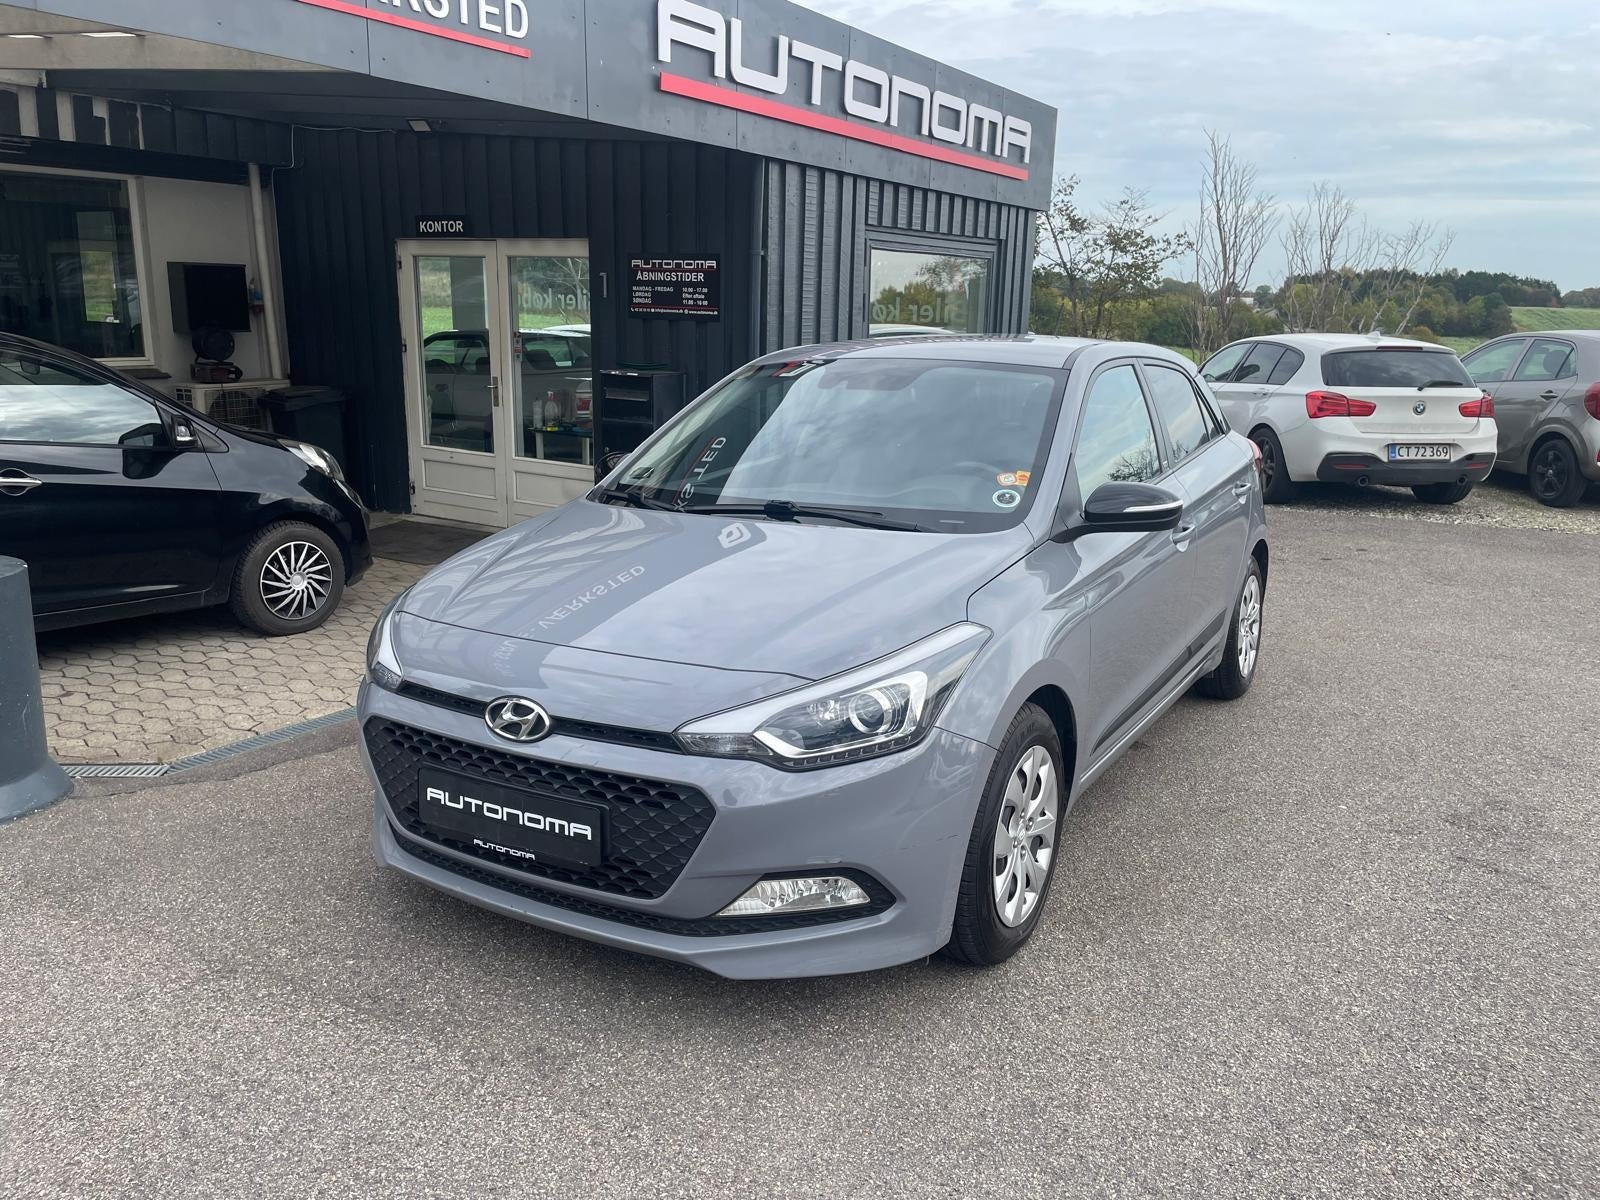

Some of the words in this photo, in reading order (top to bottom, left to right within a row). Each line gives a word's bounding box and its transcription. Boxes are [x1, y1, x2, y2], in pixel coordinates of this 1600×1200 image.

[658, 0, 1032, 164] AUTONOMA
[419, 220, 464, 233] KONTOR
[631, 260, 717, 269] AUTONOMA
[636, 271, 704, 281] ÅBNINGSTIDER
[1397, 446, 1412, 458] CT
[1414, 446, 1427, 458] 72
[1429, 446, 1449, 458] 369
[426, 787, 592, 841] AUTONOMA
[473, 838, 536, 861] AUTONOMA
